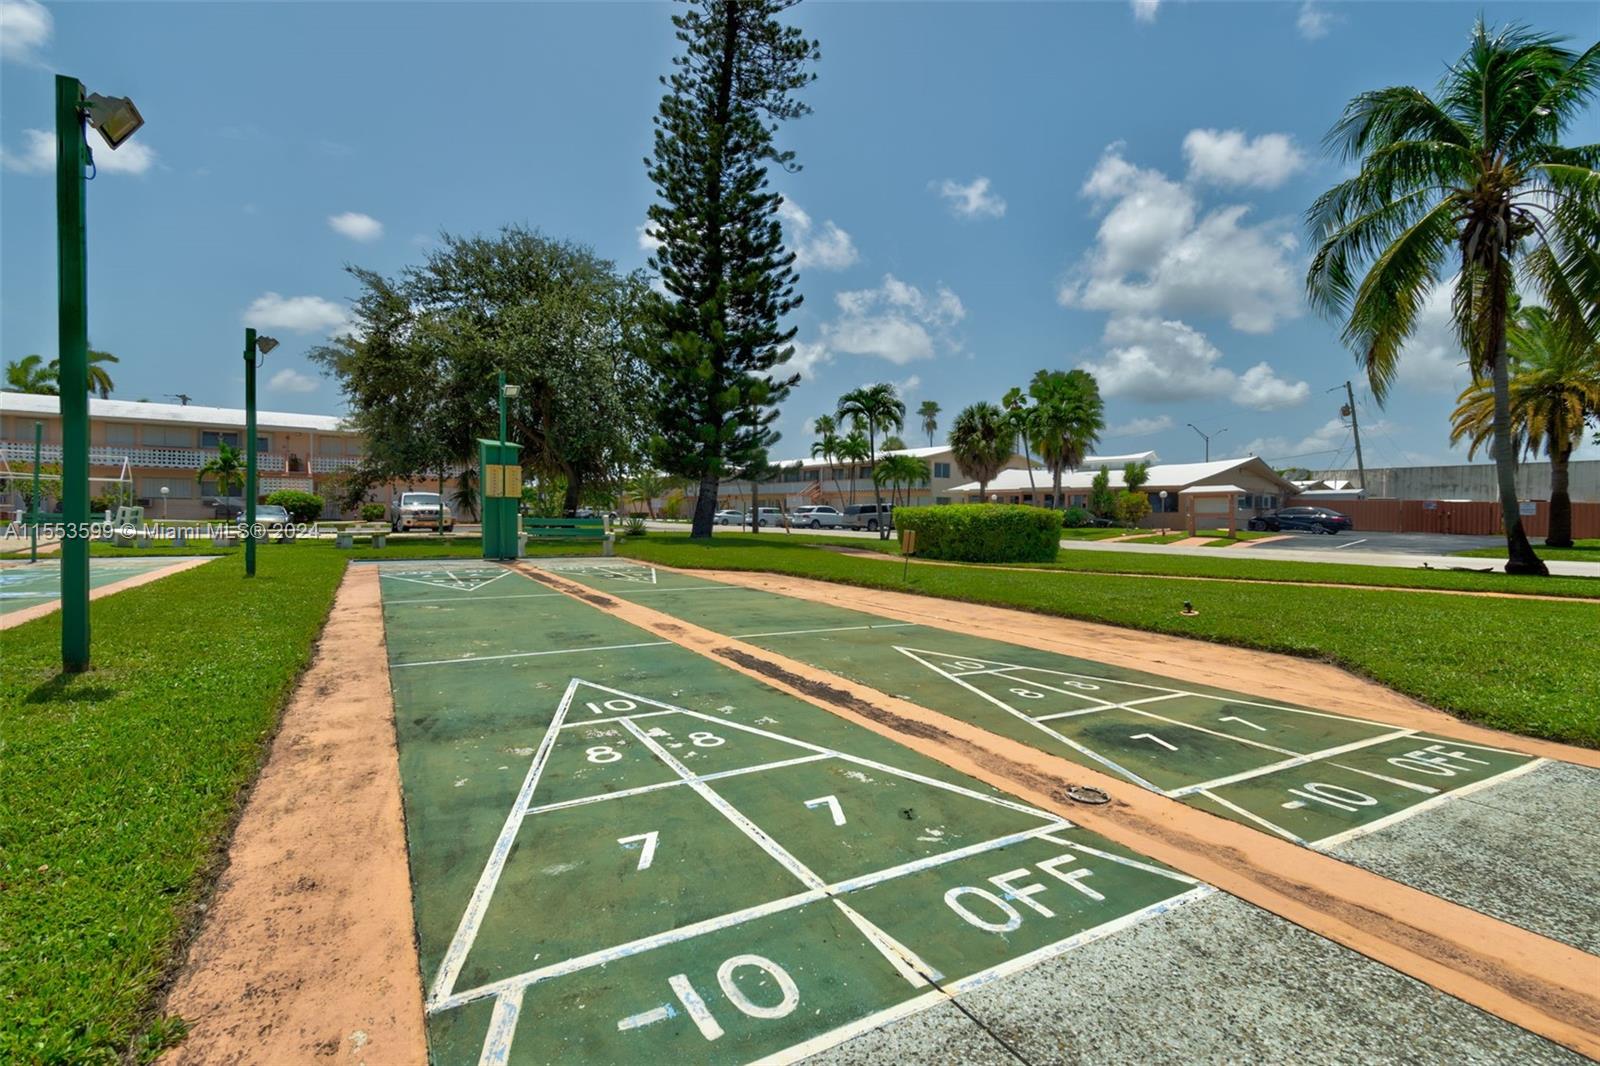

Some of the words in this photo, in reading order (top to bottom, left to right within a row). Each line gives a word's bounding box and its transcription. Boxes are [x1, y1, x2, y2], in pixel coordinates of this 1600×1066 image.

[943, 660, 985, 671] 10
[1009, 687, 1045, 699] 8
[1063, 680, 1100, 690] 8
[586, 699, 637, 715] 10
[1218, 716, 1266, 731] 7
[688, 731, 726, 747] 8
[1130, 733, 1178, 751] 7
[585, 746, 623, 763] 8
[1387, 744, 1490, 777] OFF
[804, 795, 847, 826] 7
[617, 831, 660, 871] 7
[943, 853, 1106, 933] OFF
